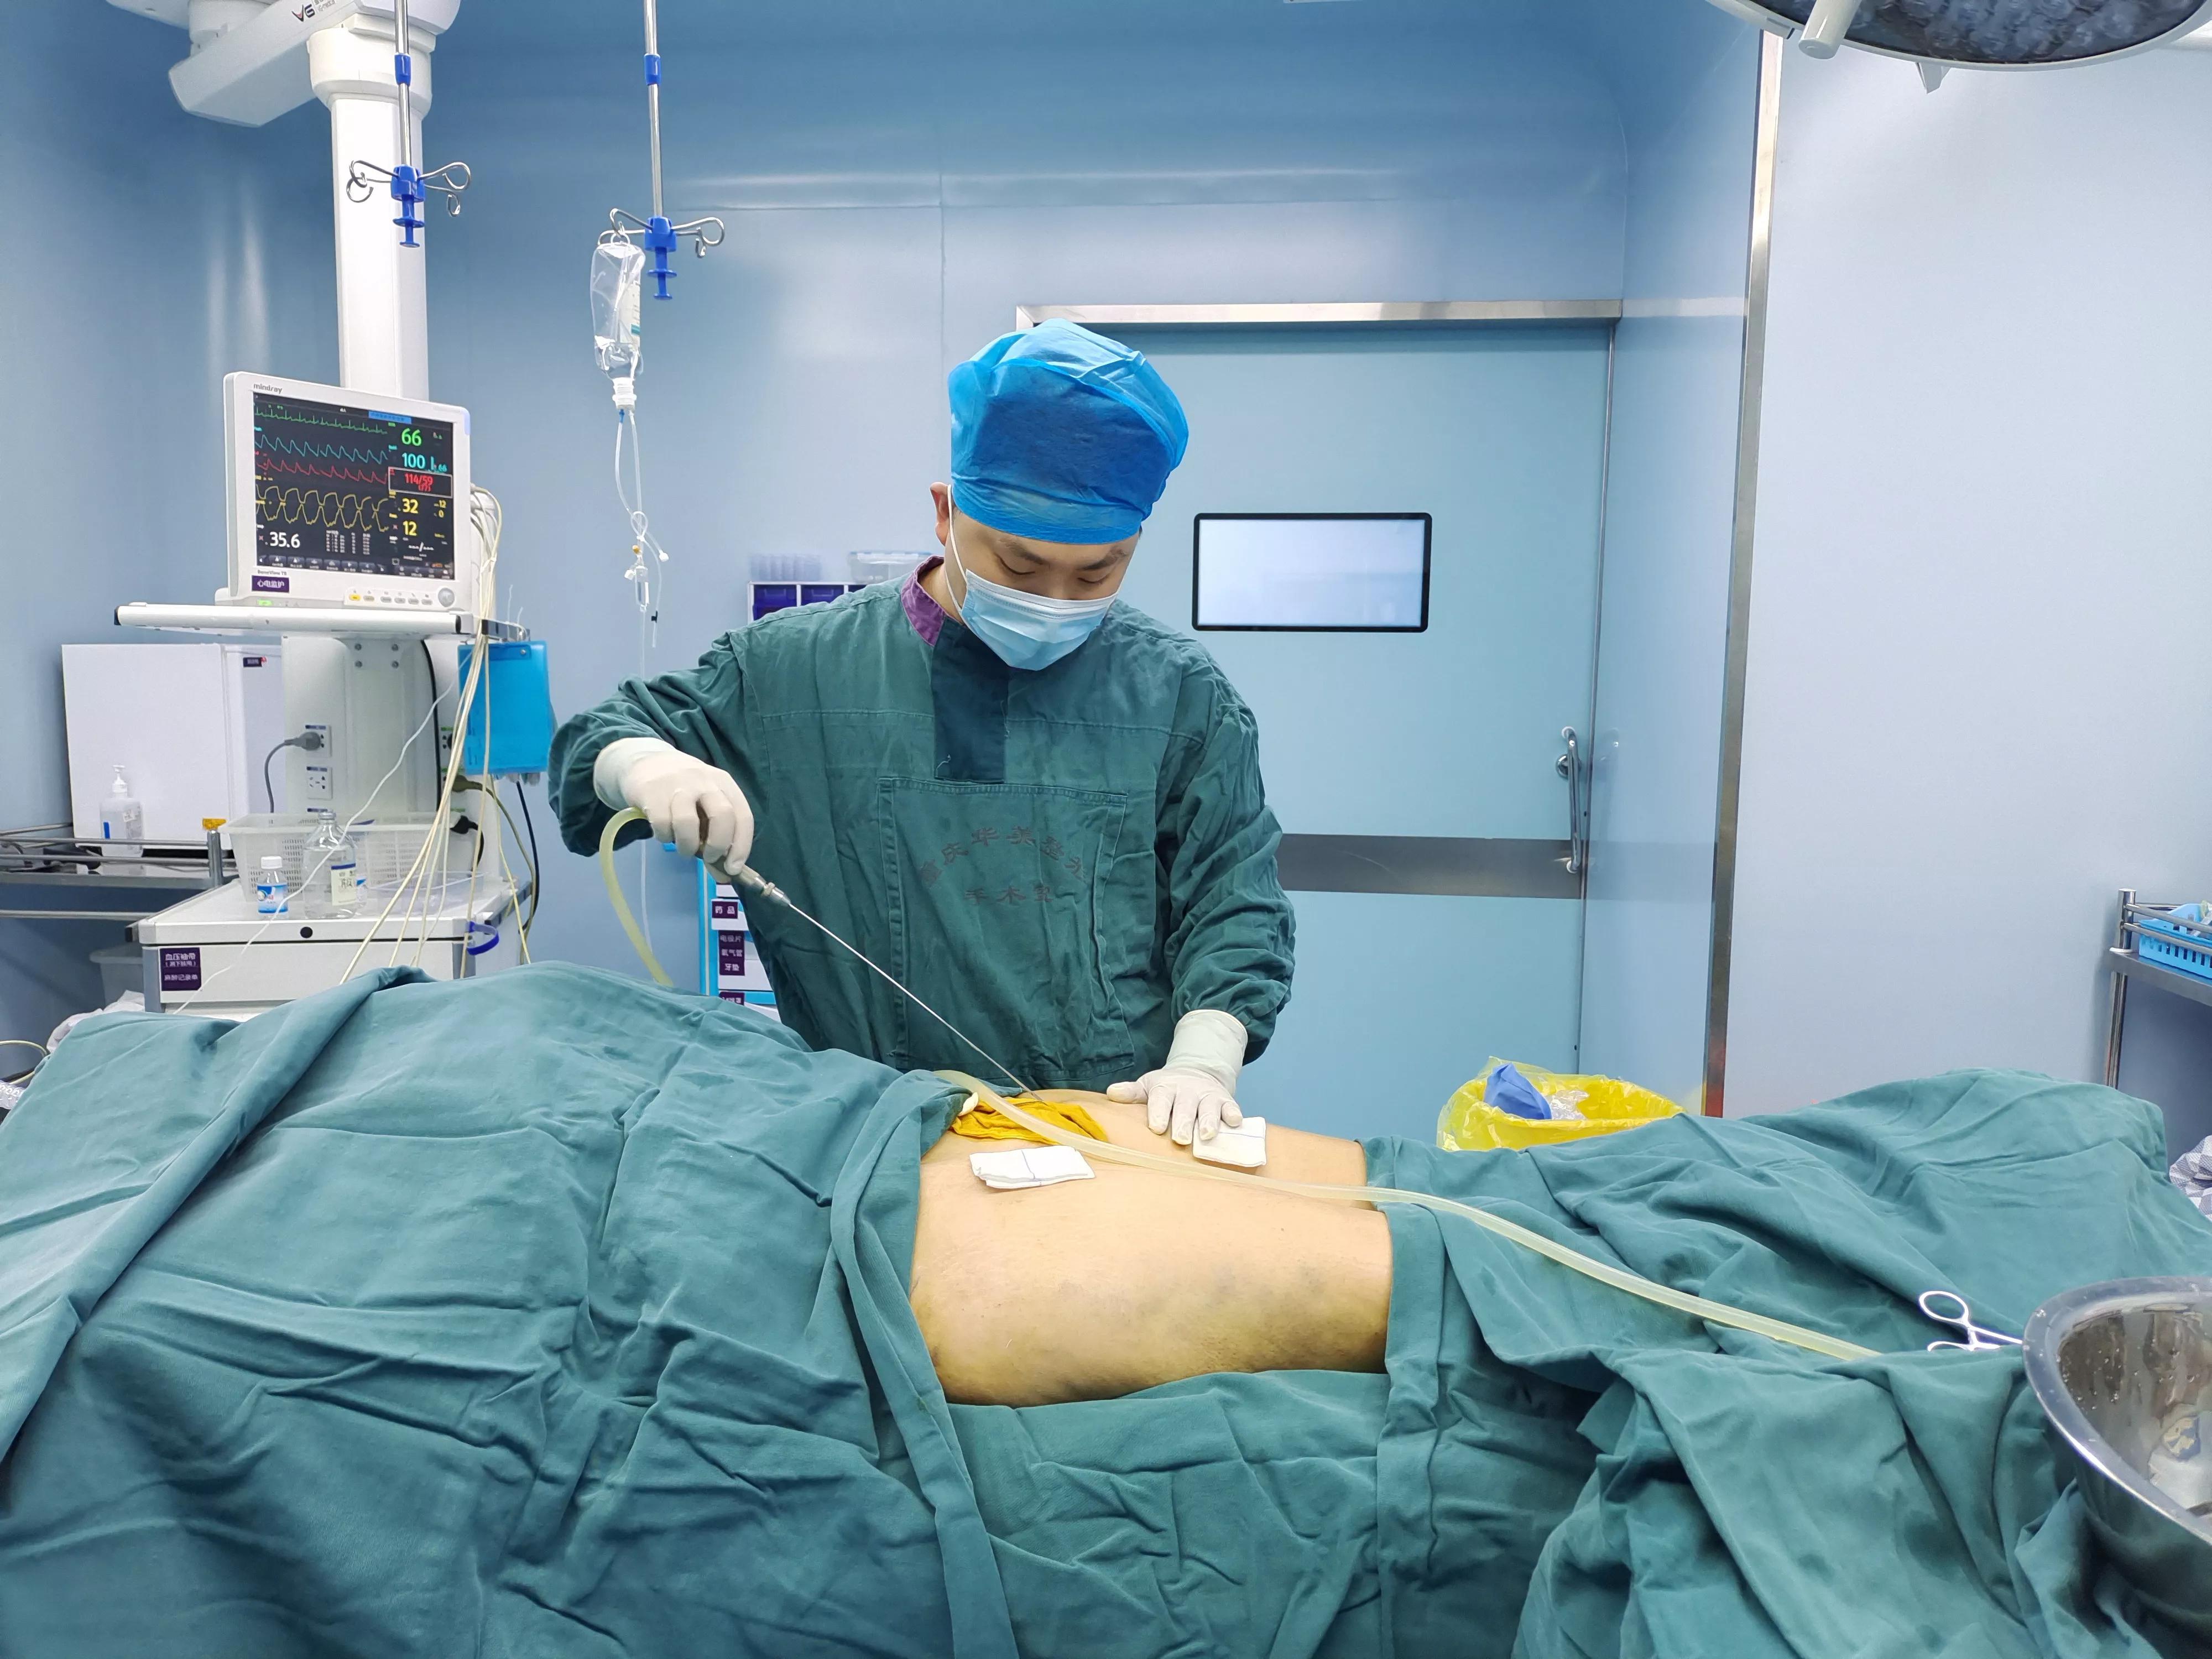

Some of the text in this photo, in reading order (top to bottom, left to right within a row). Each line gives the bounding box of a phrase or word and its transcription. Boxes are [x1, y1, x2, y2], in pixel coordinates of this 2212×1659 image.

[253, 383, 283, 394] mindray
[401, 427, 422, 446] 66
[402, 452, 425, 469] 100
[405, 473, 434, 486] 114/59
[403, 498, 418, 514] 32
[403, 520, 417, 536] 12
[269, 531, 300, 548] 35.6
